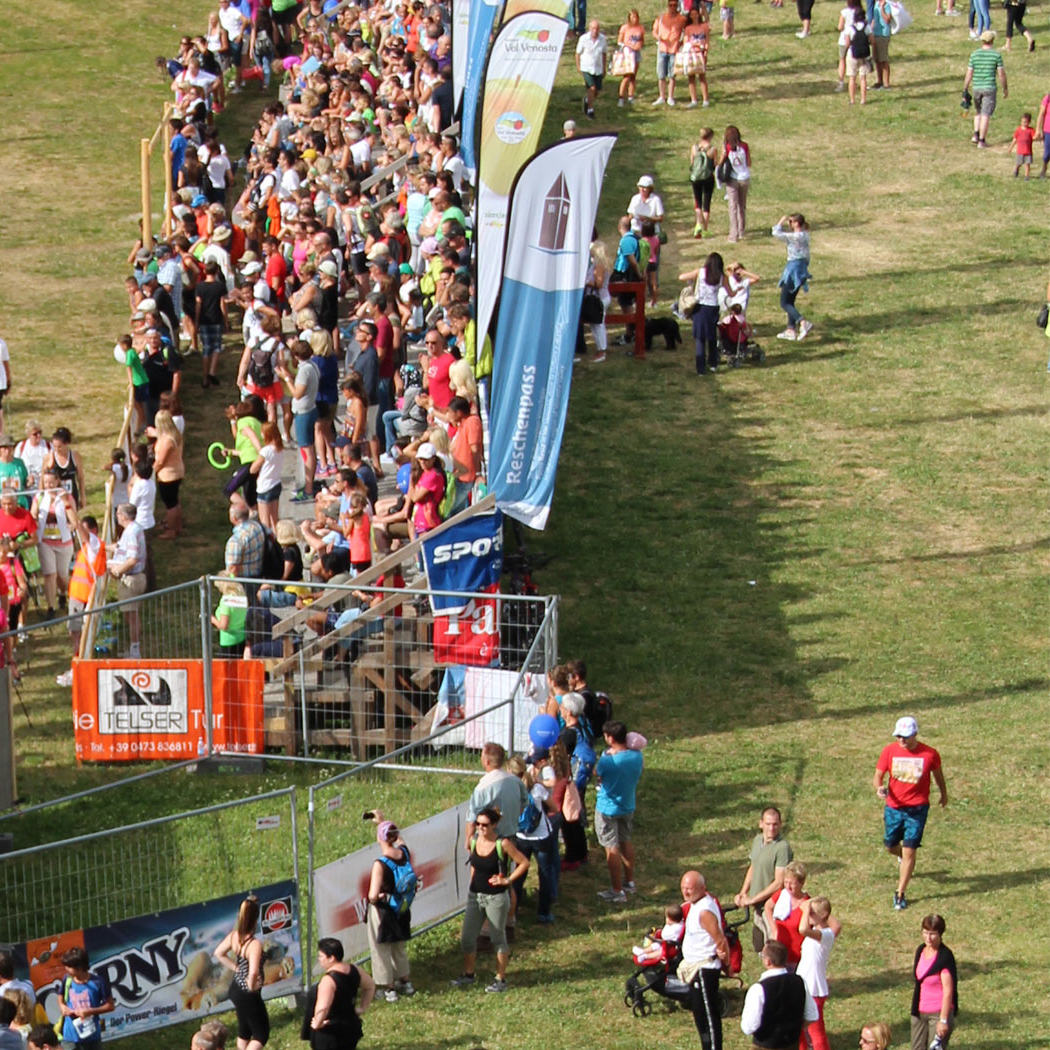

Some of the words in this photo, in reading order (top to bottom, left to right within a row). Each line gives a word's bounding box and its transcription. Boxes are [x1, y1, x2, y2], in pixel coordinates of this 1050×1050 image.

[522, 43, 557, 53] Venosta
[506, 364, 537, 484] Reschenpass
[104, 711, 183, 729] TELSER
[110, 743, 128, 752] +39
[131, 742, 155, 752] 0473
[157, 741, 192, 752] 836811
[110, 1016, 123, 1027] Der
[125, 1003, 178, 1025] Power-Riegel
